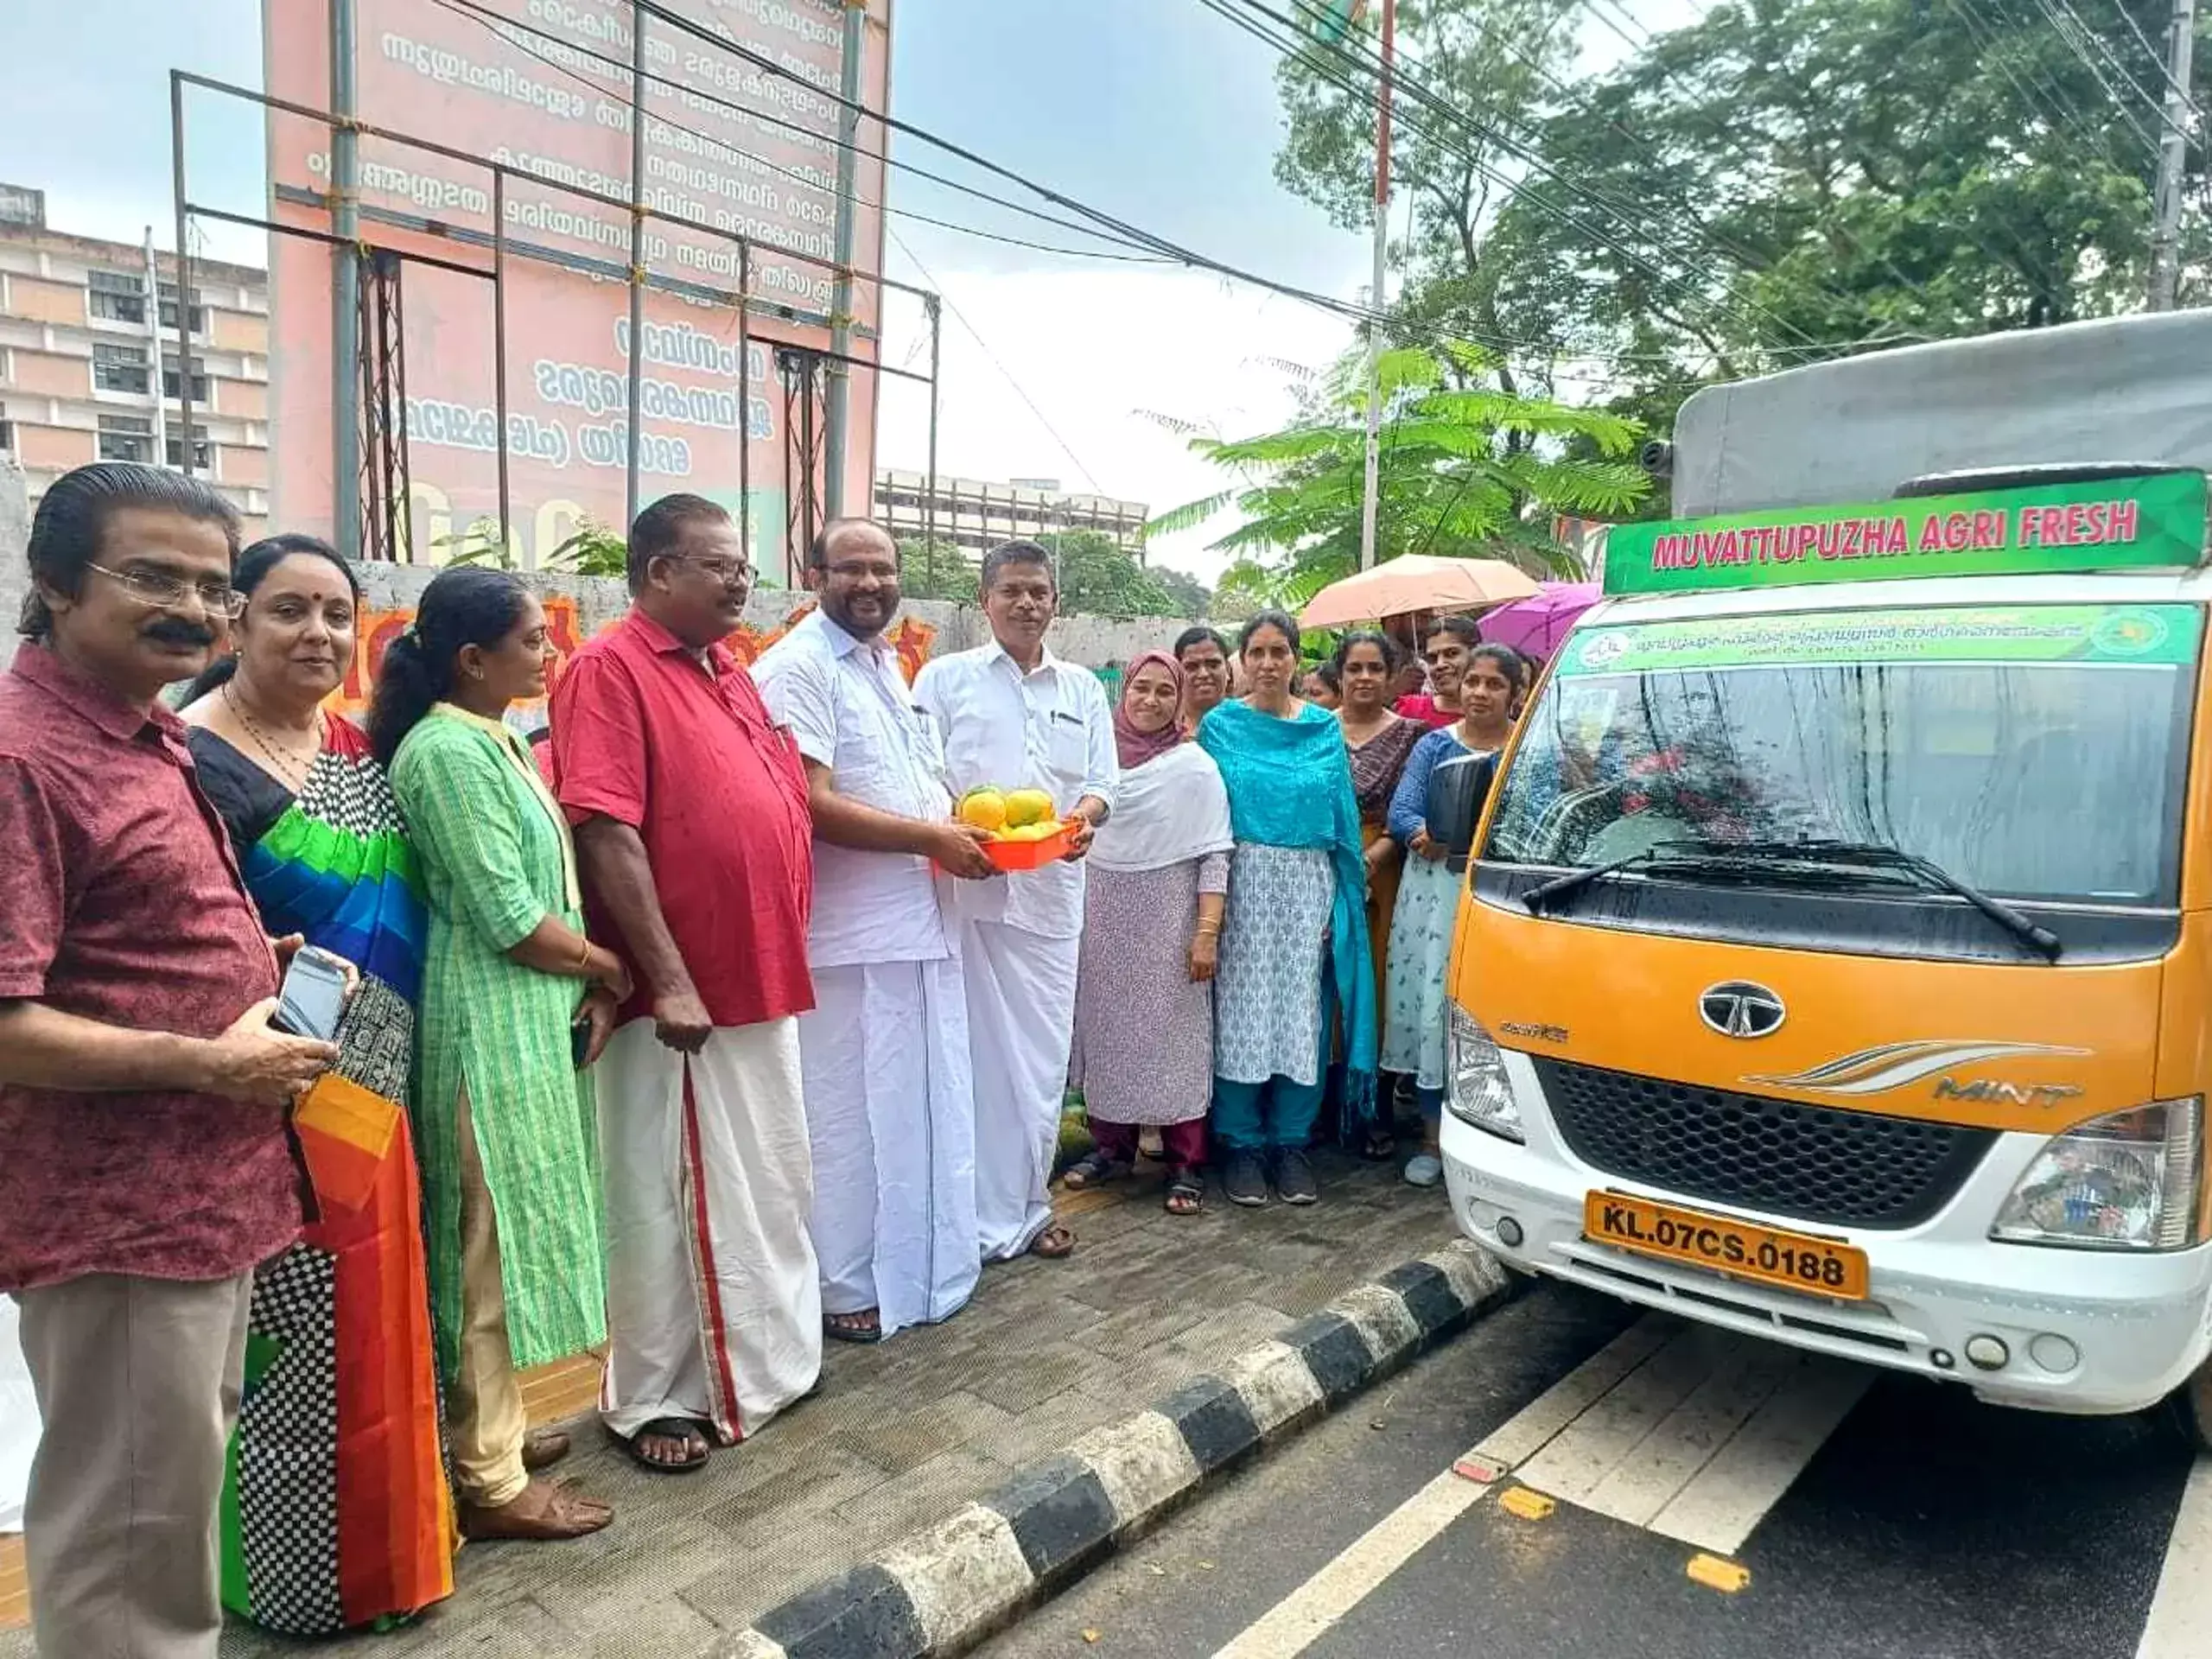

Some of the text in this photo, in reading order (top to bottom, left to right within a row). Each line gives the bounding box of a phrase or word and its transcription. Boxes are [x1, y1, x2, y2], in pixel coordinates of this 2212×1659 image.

[1652, 499, 2139, 571] MUVATTUPUZHA AGRI FRESH
[1932, 1076, 2085, 1109] MINT
[1603, 1202, 1845, 1287] KL.07CS.0188
